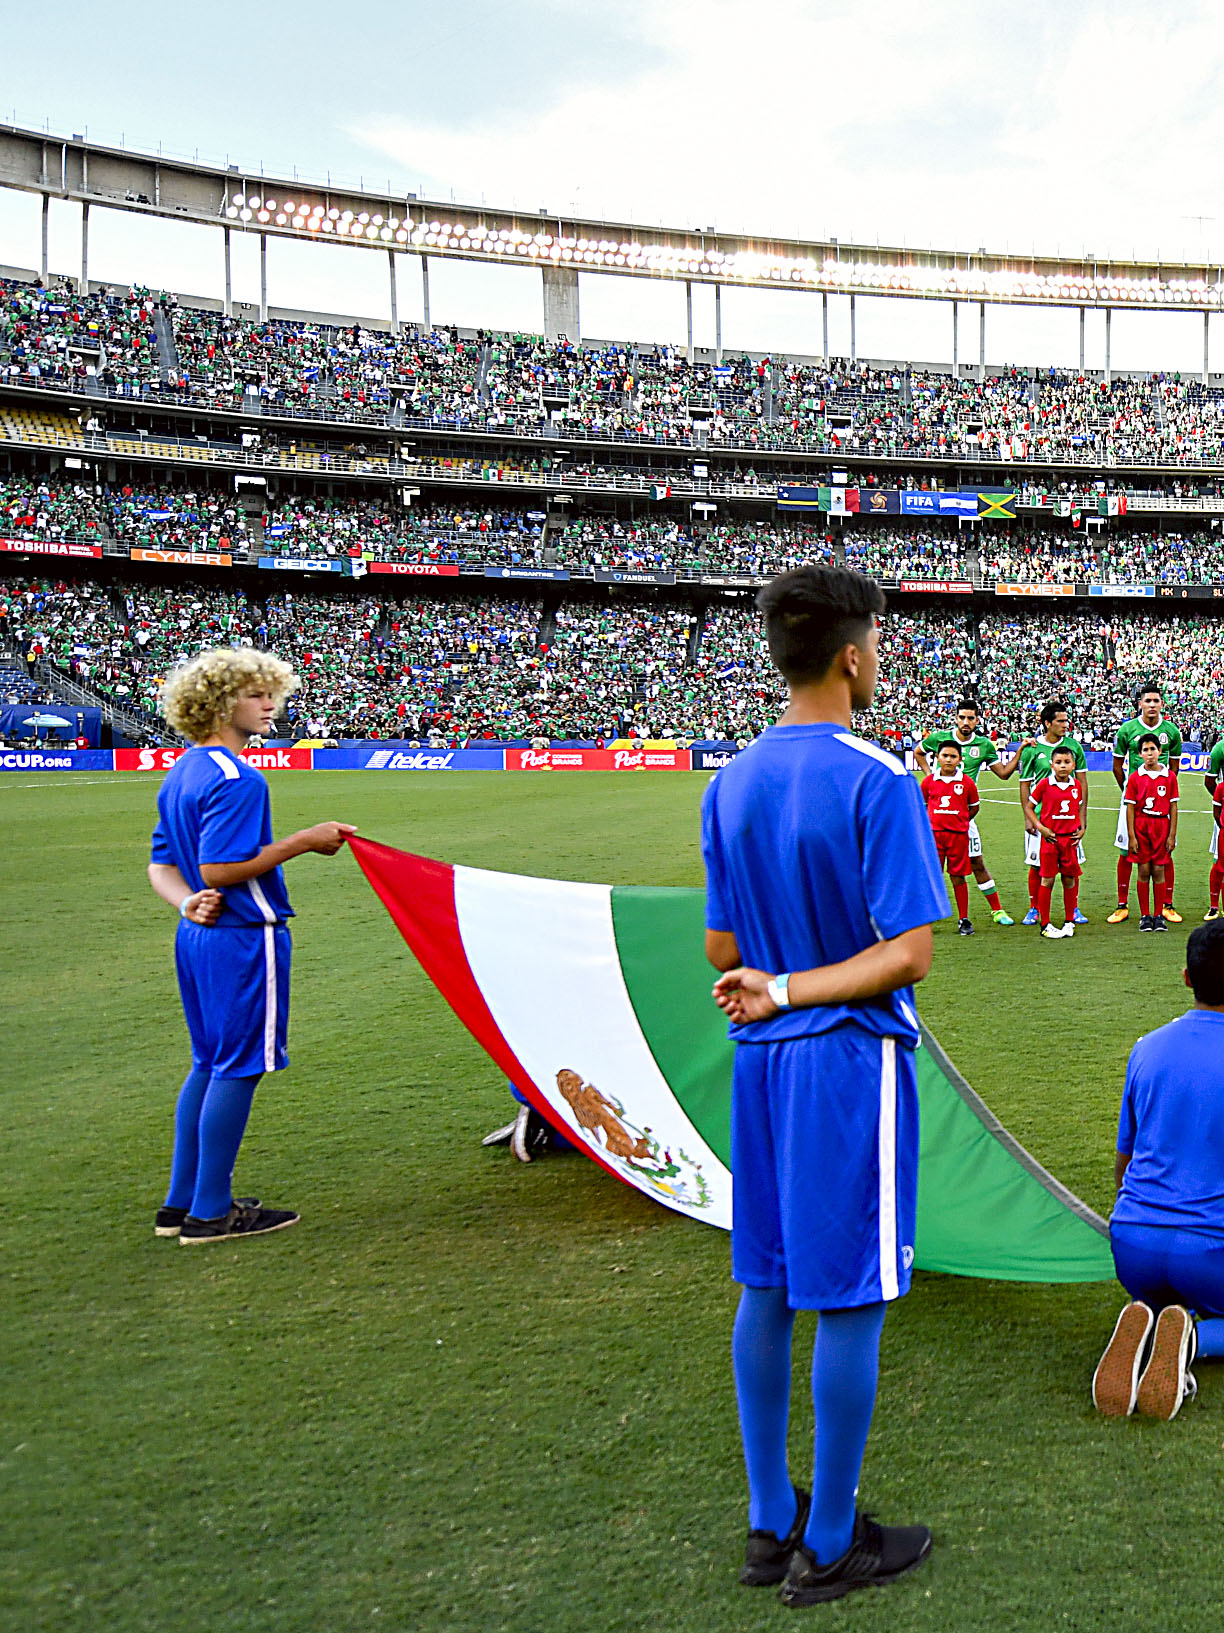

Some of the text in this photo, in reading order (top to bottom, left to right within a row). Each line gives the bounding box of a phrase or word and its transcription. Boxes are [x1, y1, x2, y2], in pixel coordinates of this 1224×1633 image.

[906, 496, 934, 506] FIFA
[4, 540, 68, 554] TOSHIBA
[141, 550, 222, 566] CYMER
[273, 558, 331, 571] GEICO
[390, 564, 440, 575] TOYOTA
[622, 574, 657, 582] FANDUEL
[902, 582, 948, 592] TOSHIBA
[1007, 584, 1064, 595] CYMER
[1102, 585, 1146, 596] GEICO
[1181, 590, 1188, 598] 0
[0, 754, 72, 768] CUP.ORG
[388, 752, 454, 769] telcel
[520, 750, 551, 769] Post
[614, 750, 645, 769] Post
[970, 837, 980, 852] 15
